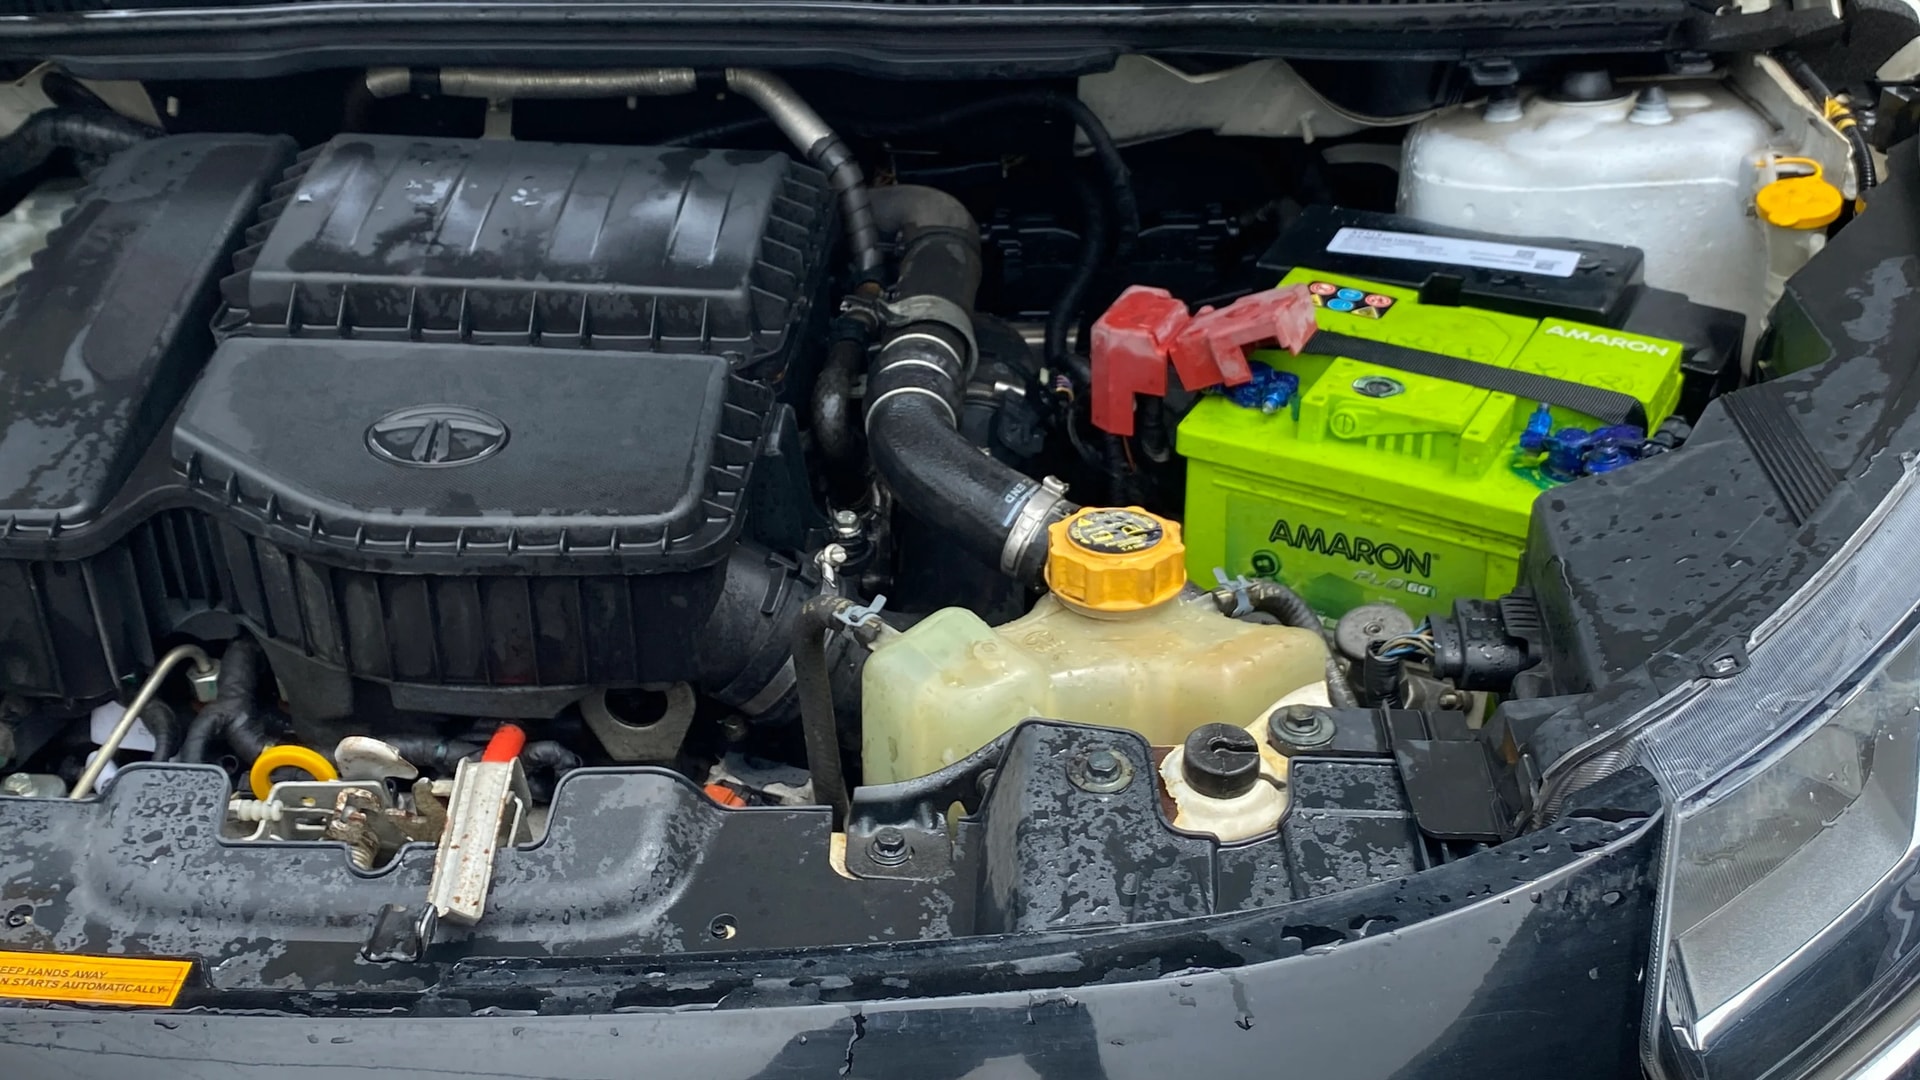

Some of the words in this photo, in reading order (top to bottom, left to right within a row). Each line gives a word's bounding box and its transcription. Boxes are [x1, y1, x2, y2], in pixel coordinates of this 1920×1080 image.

[1545, 325, 1669, 357] AMARON
[1269, 519, 1431, 578] AMARON
[0, 966, 24, 975] EEP
[26, 967, 69, 977] HANDS
[71, 970, 107, 979] AWAY
[12, 977, 59, 988] STARTS
[62, 980, 165, 994] AUTOMATICALLY
